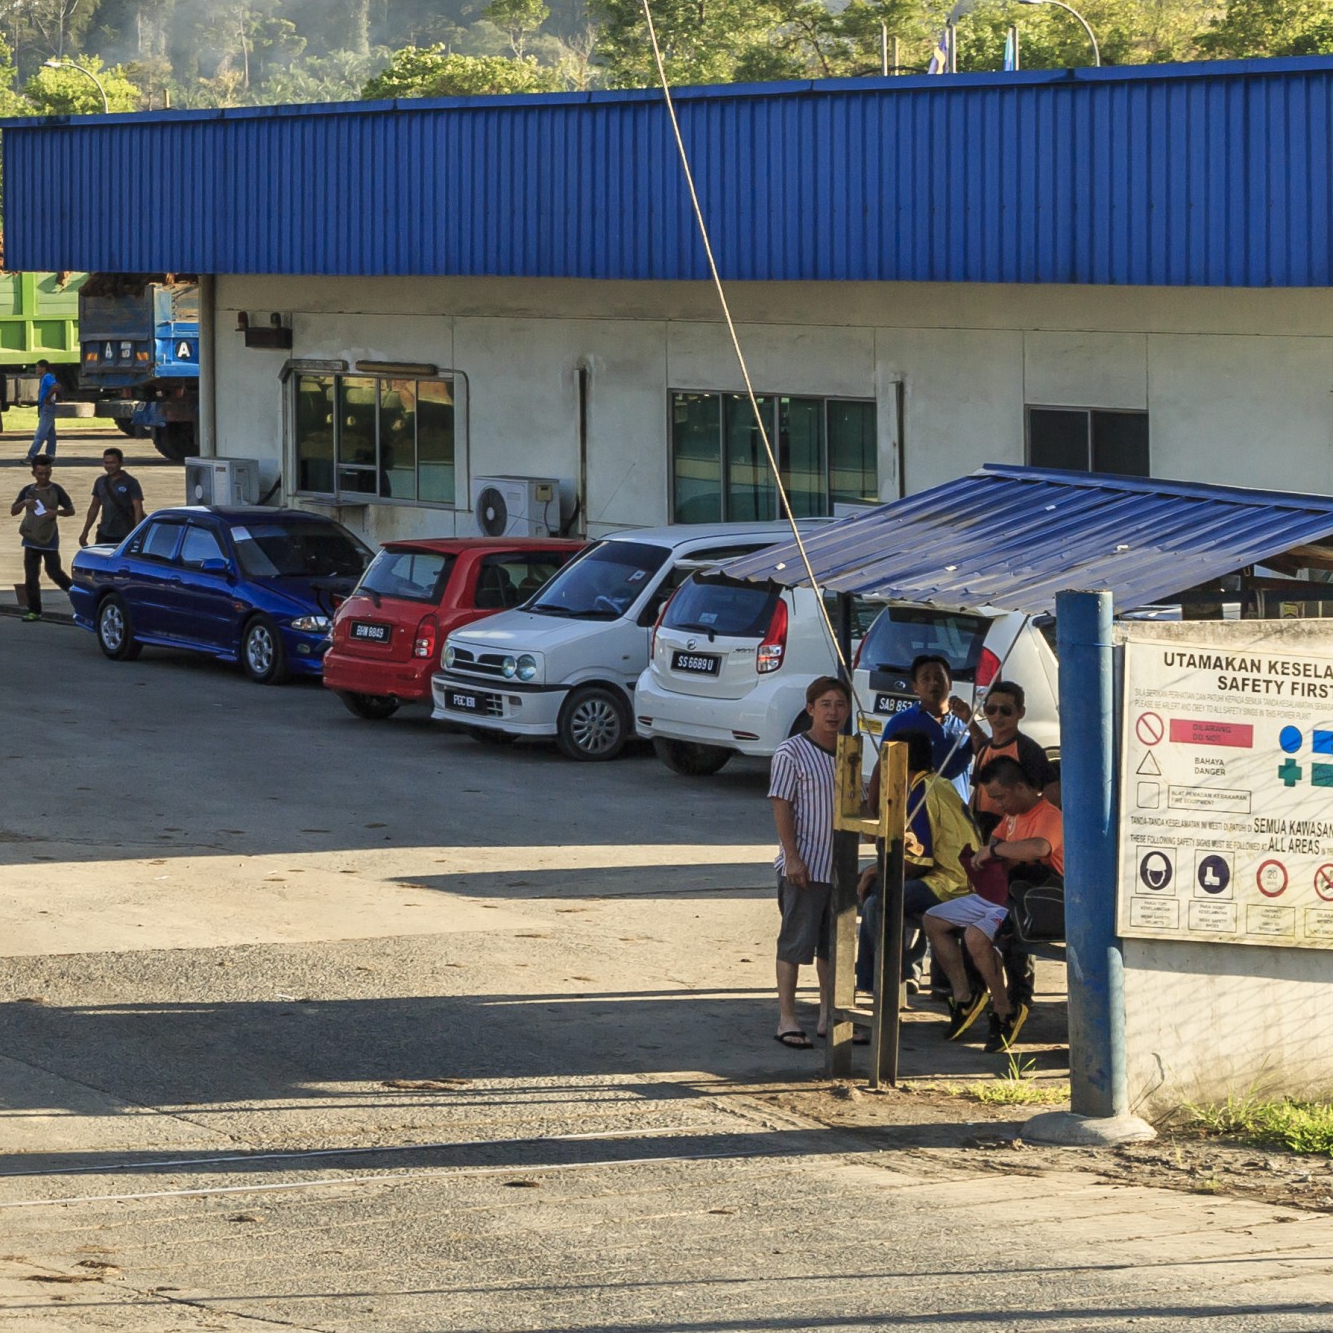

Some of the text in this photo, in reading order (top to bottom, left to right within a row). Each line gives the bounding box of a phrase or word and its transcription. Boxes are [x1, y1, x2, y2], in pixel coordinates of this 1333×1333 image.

[177, 342, 191, 358] A
[678, 656, 713, 671] SS 6689 U
[1164, 652, 1333, 679] UTAMAKAN KESELA
[1217, 676, 1285, 695] SAFETY
[879, 697, 895, 710] SAB
[1195, 757, 1224, 766] BAHAYA
[1195, 767, 1225, 776] DANGER
[1253, 817, 1286, 835] SEMUA
[1176, 837, 1194, 846] SAFETY
[1268, 837, 1285, 852] ALL
[1288, 837, 1319, 855] AREAS
[1267, 870, 1277, 879] 20
